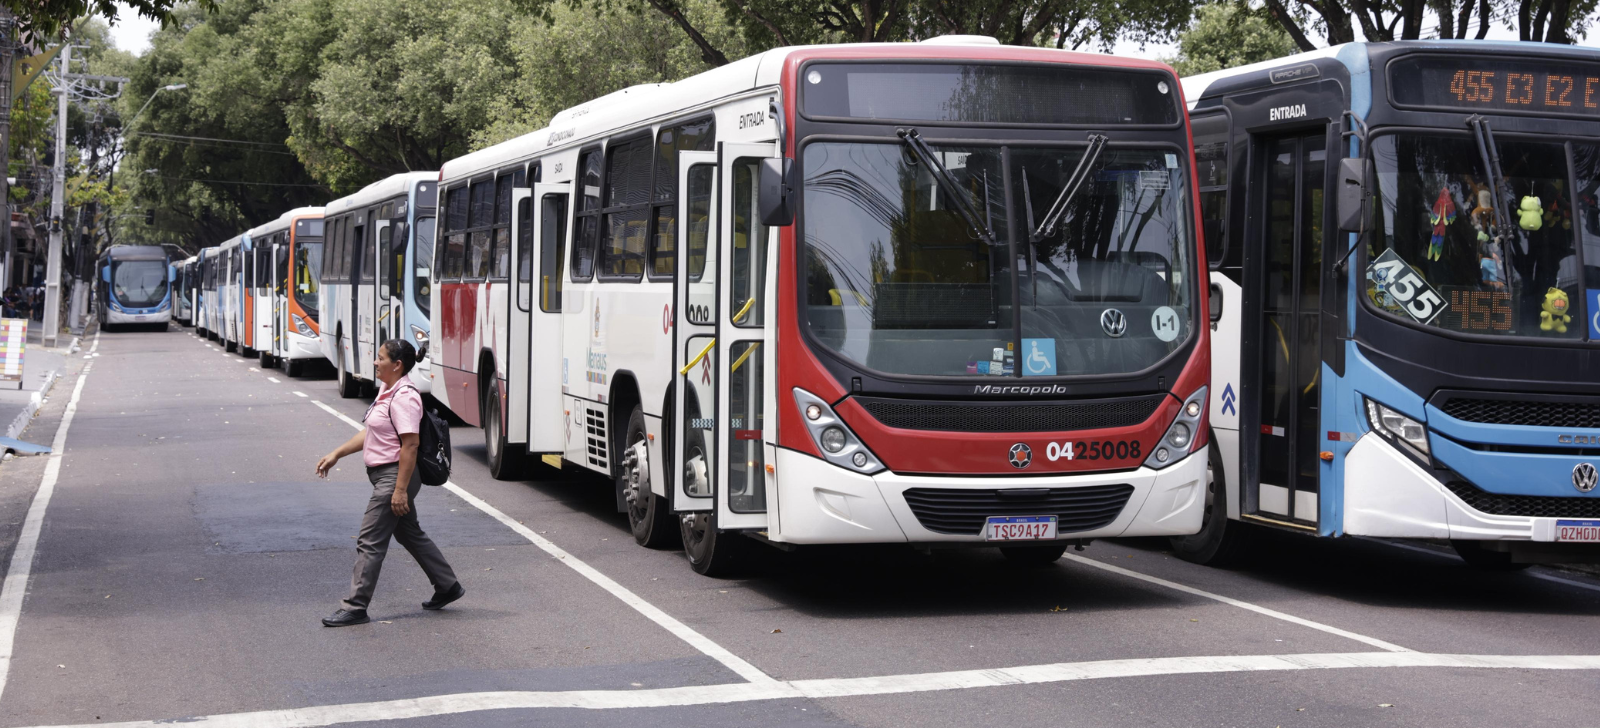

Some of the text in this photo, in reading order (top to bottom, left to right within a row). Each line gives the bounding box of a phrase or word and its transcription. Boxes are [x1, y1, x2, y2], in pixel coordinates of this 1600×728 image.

[1450, 70, 1495, 102] 455
[1505, 73, 1534, 104] E3
[1545, 75, 1573, 106] E2
[739, 110, 765, 130] ENTRADA
[1269, 103, 1307, 121] ENTRADA
[1373, 259, 1442, 319] 455
[1451, 290, 1512, 330] 455
[973, 384, 1067, 396] Marcopolo
[1558, 434, 1600, 444] CAI
[1046, 440, 1141, 461] 0425008
[993, 523, 1049, 539] TSC9A17
